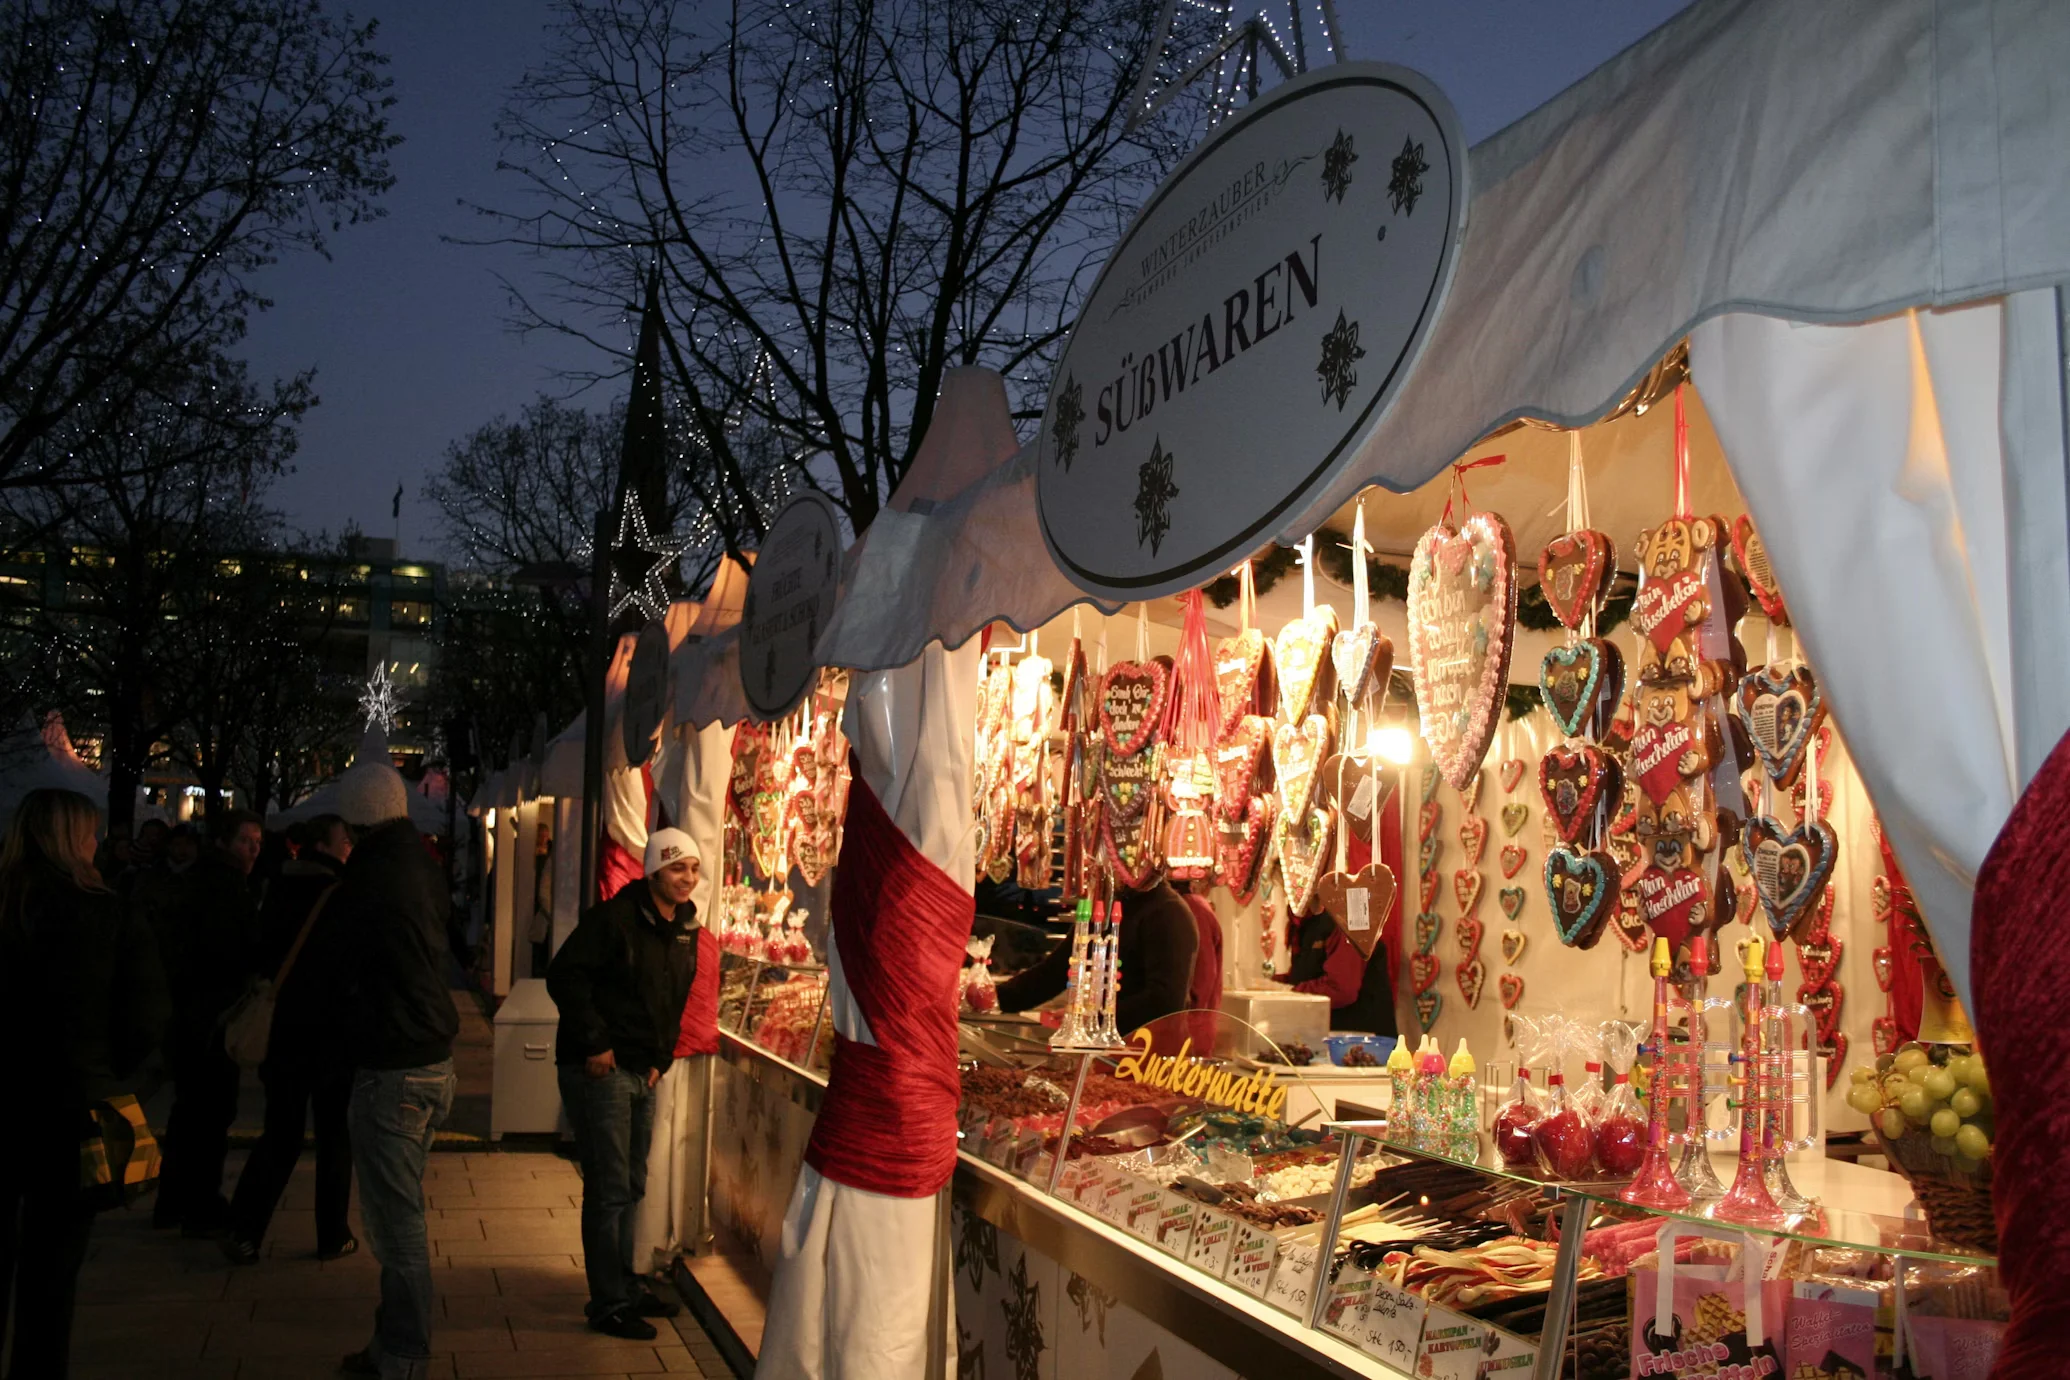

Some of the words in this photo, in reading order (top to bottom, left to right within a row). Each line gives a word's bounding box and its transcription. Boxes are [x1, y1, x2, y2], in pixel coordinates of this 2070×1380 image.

[1140, 160, 1266, 279] WINTERZAUBER
[1114, 1027, 1288, 1120] Zuckerwatte
[1791, 1310, 1843, 1331] Waffel-
[1791, 1324, 1874, 1352] Spezialitäten
[1637, 1342, 1730, 1378] Frische
